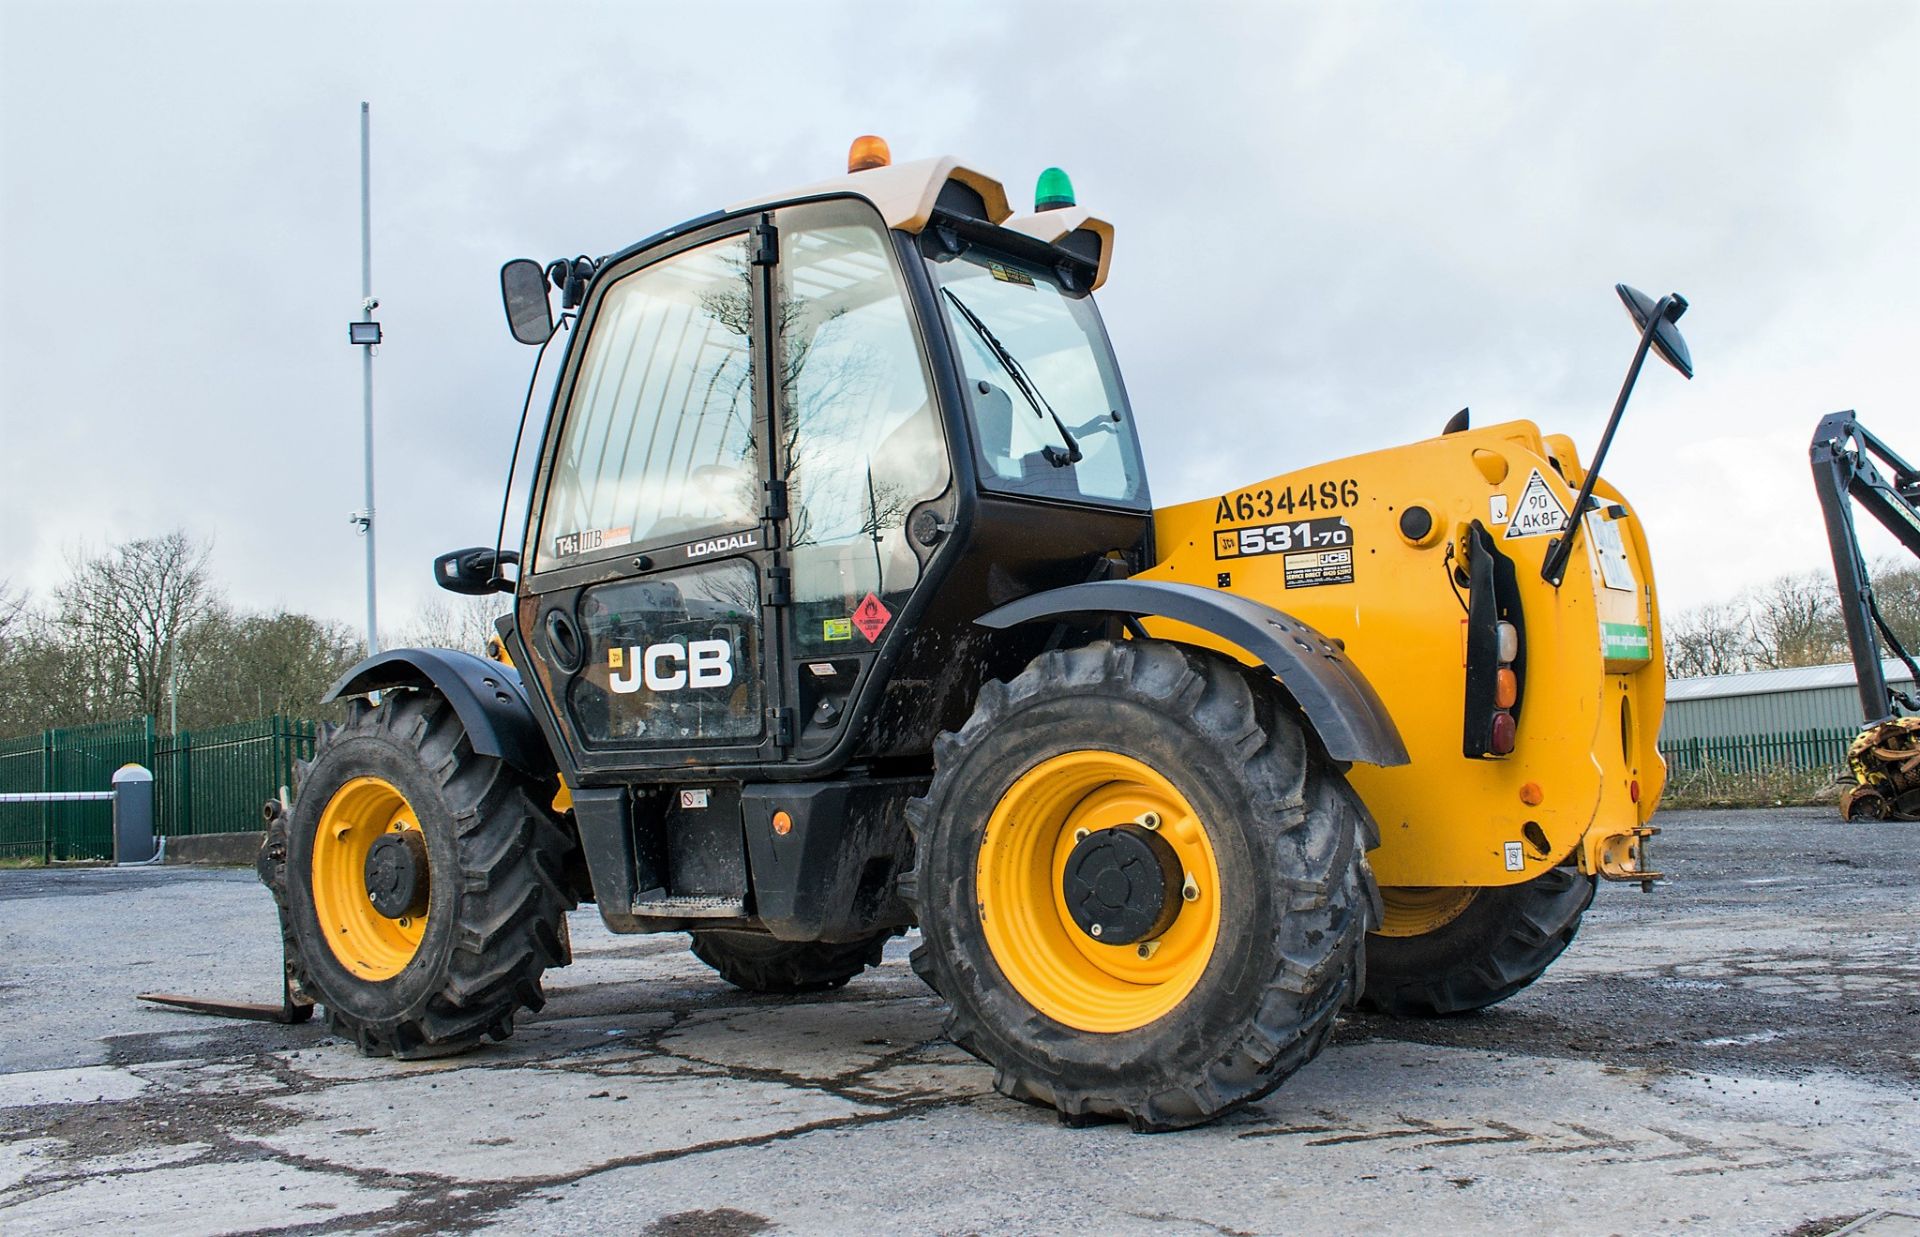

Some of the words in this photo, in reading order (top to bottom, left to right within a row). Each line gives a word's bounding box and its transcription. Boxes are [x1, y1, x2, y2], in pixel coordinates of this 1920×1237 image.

[1522, 511, 1559, 528] AK8F
[557, 535, 579, 555] T4i
[687, 534, 757, 557] LOADALL
[1240, 523, 1347, 554] 531-70
[1320, 552, 1348, 564] JCB
[608, 639, 733, 694] JCB
